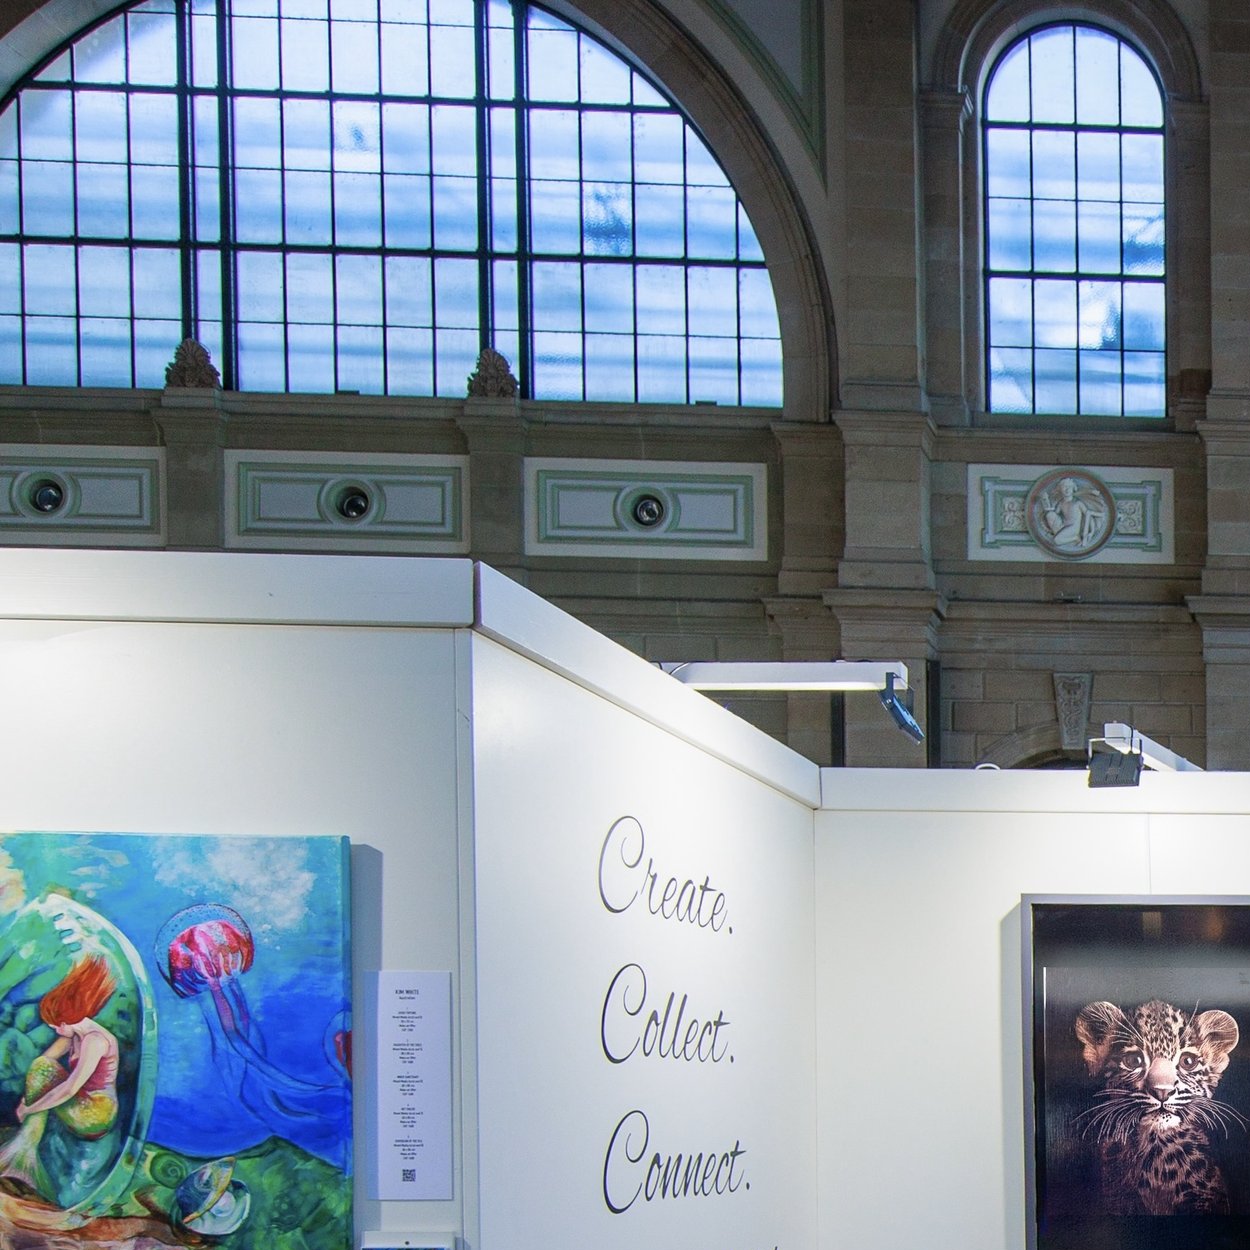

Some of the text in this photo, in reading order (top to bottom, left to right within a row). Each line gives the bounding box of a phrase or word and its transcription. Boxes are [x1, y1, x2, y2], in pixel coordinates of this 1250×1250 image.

[598, 815, 733, 935] Create.
[601, 963, 734, 1064] Collect.
[603, 1110, 750, 1215] Connect.
